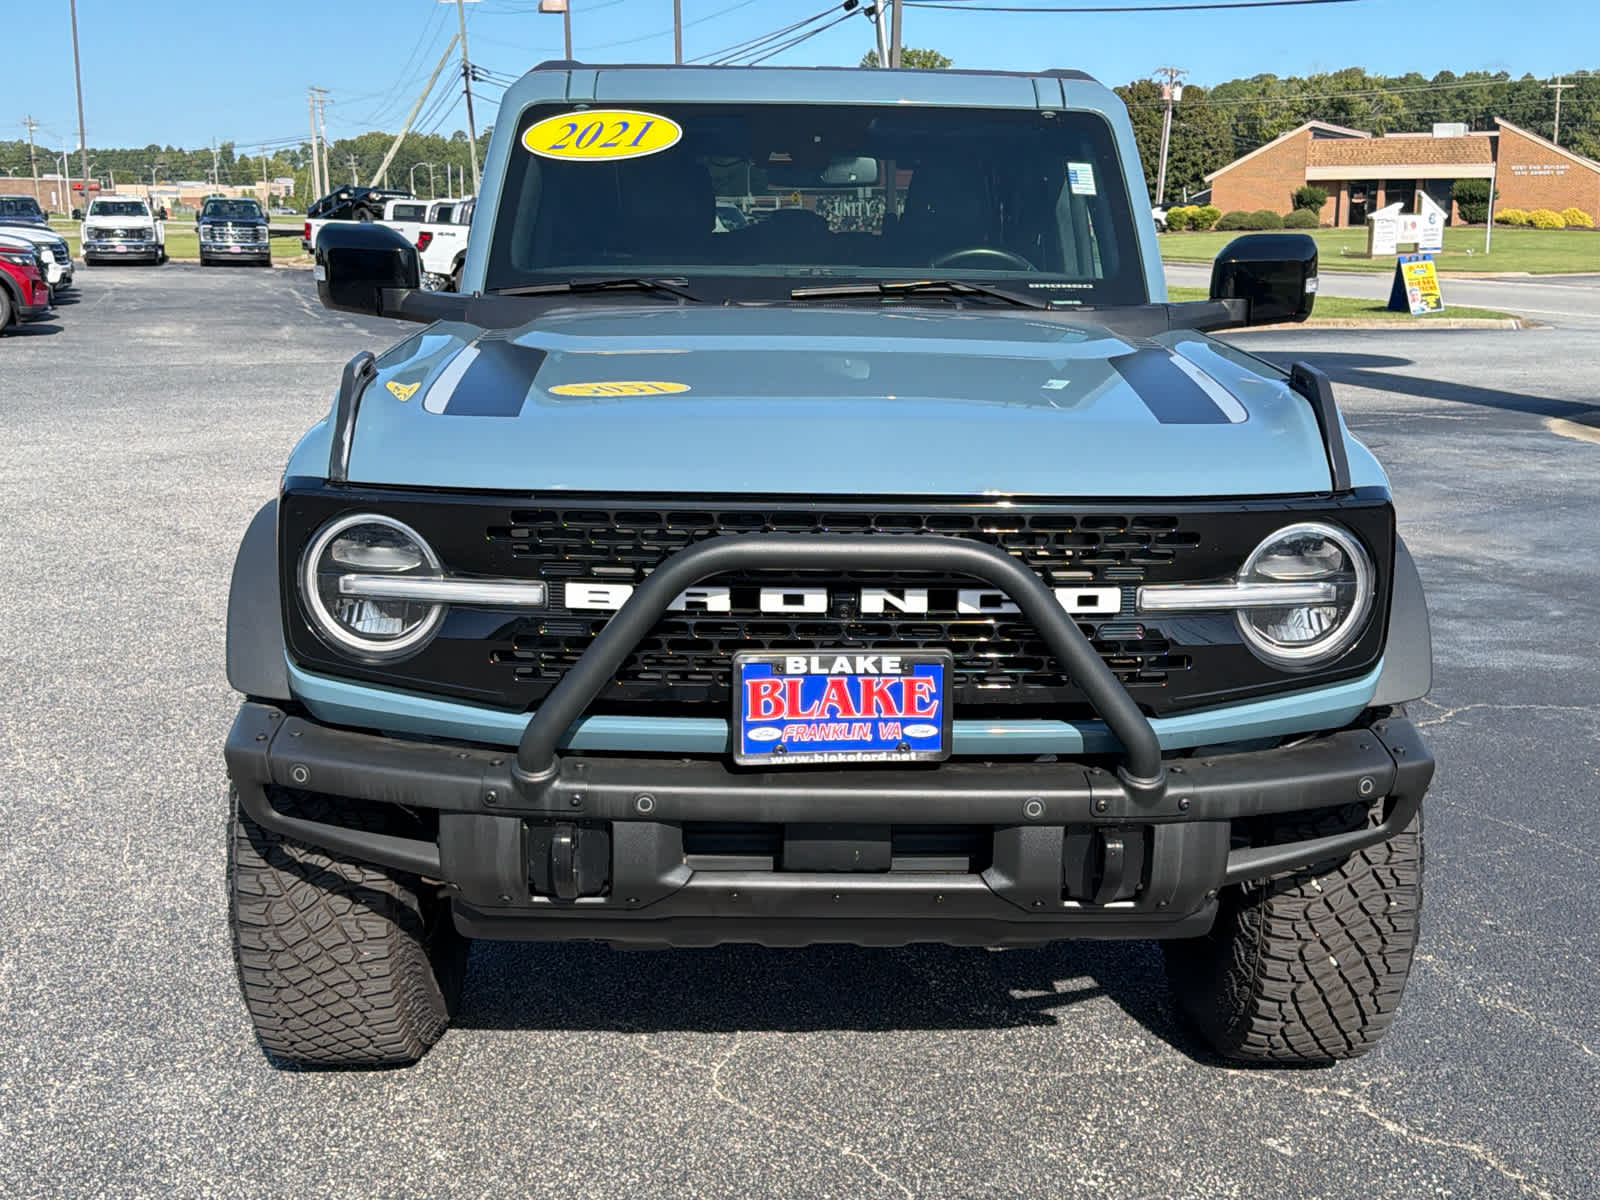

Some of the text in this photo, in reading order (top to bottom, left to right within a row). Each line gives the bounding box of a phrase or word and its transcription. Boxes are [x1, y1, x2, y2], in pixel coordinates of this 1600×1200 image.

[547, 120, 656, 150] 2021
[565, 582, 1121, 614] BRONCO
[786, 656, 902, 675] BLAKE
[745, 676, 939, 721] BLAKE
[781, 722, 902, 743] FRANKLIN, VA
[770, 752, 917, 765] www.blakeford.net
